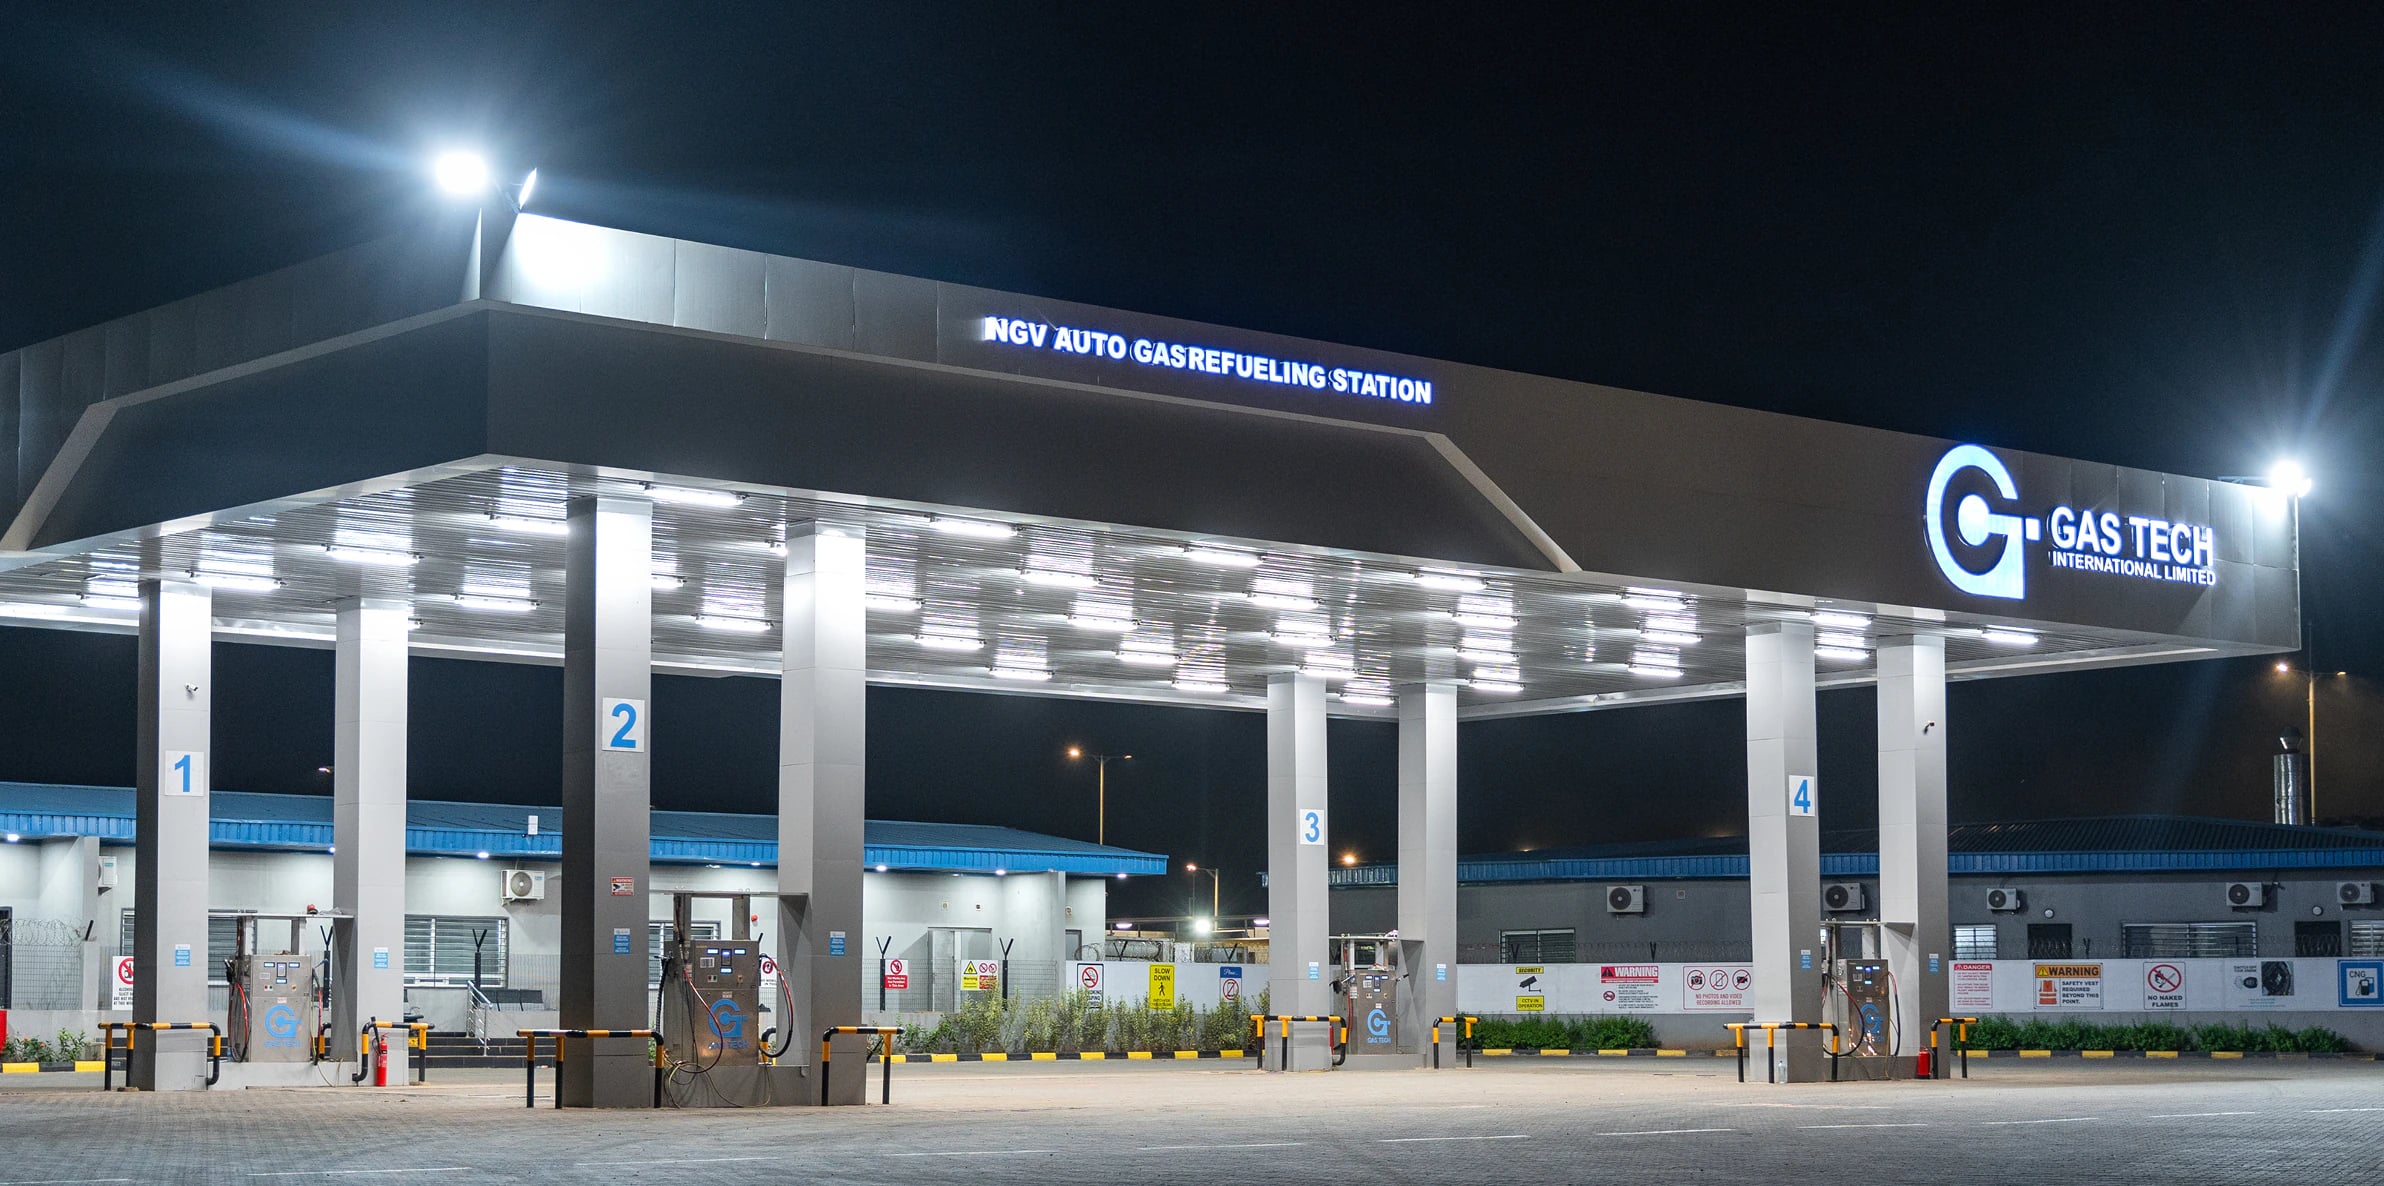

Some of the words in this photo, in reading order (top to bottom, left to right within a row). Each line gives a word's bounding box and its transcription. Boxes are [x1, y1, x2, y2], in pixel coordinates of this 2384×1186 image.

[984, 316, 1048, 347] NGV
[1054, 327, 1126, 360] AUTO
[1332, 368, 1432, 404] STATION
[2051, 506, 2121, 556] GAS
[2128, 516, 2214, 566] TECH
[2052, 551, 2162, 580] INTERNATIONAL
[2164, 567, 2217, 586] LIMITED
[610, 703, 636, 748] 2
[175, 754, 190, 792] 1
[1794, 780, 1811, 813] 4
[1305, 812, 1320, 842] 3
[1615, 967, 1658, 977] WARNING
[2049, 967, 2099, 976] WARNING
